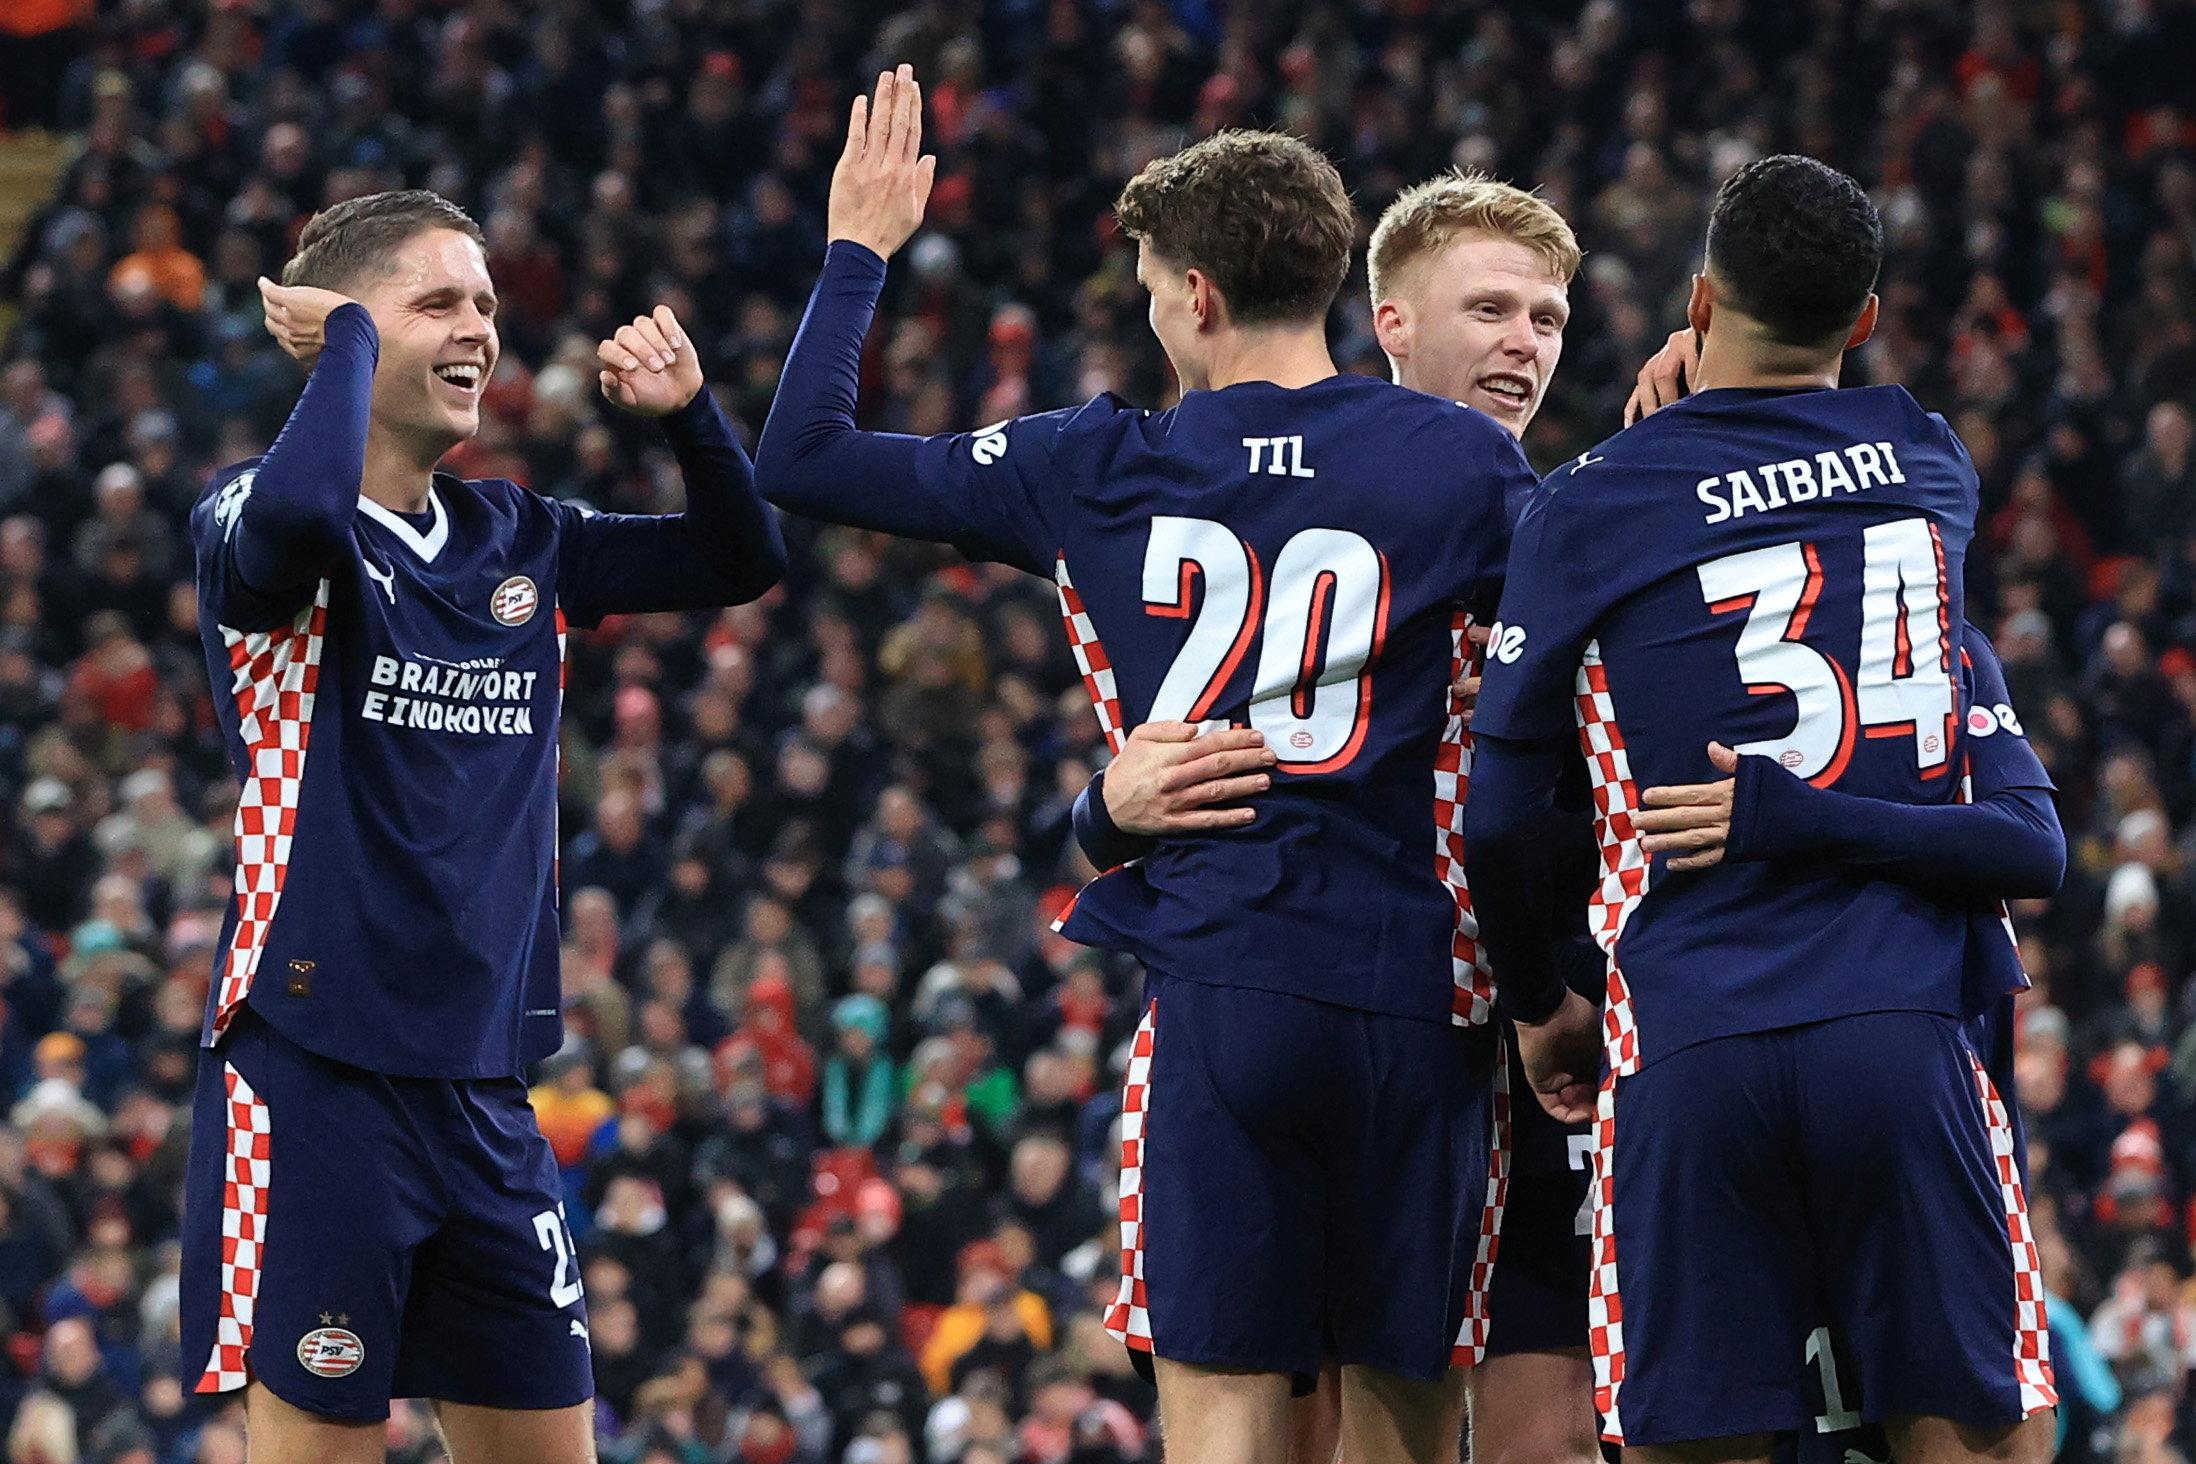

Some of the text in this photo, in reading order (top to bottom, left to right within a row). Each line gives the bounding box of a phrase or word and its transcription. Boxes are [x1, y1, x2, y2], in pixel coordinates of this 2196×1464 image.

[1242, 435, 1315, 478] TIL
[1696, 441, 1907, 525] SAIBARI
[371, 655, 537, 701] BRAINORT
[1142, 516, 1391, 775] 20
[1697, 517, 1960, 790] 34
[361, 690, 534, 735] EINDHOVEN
[532, 1200, 585, 1309] 2
[320, 1345, 344, 1356] PSV
